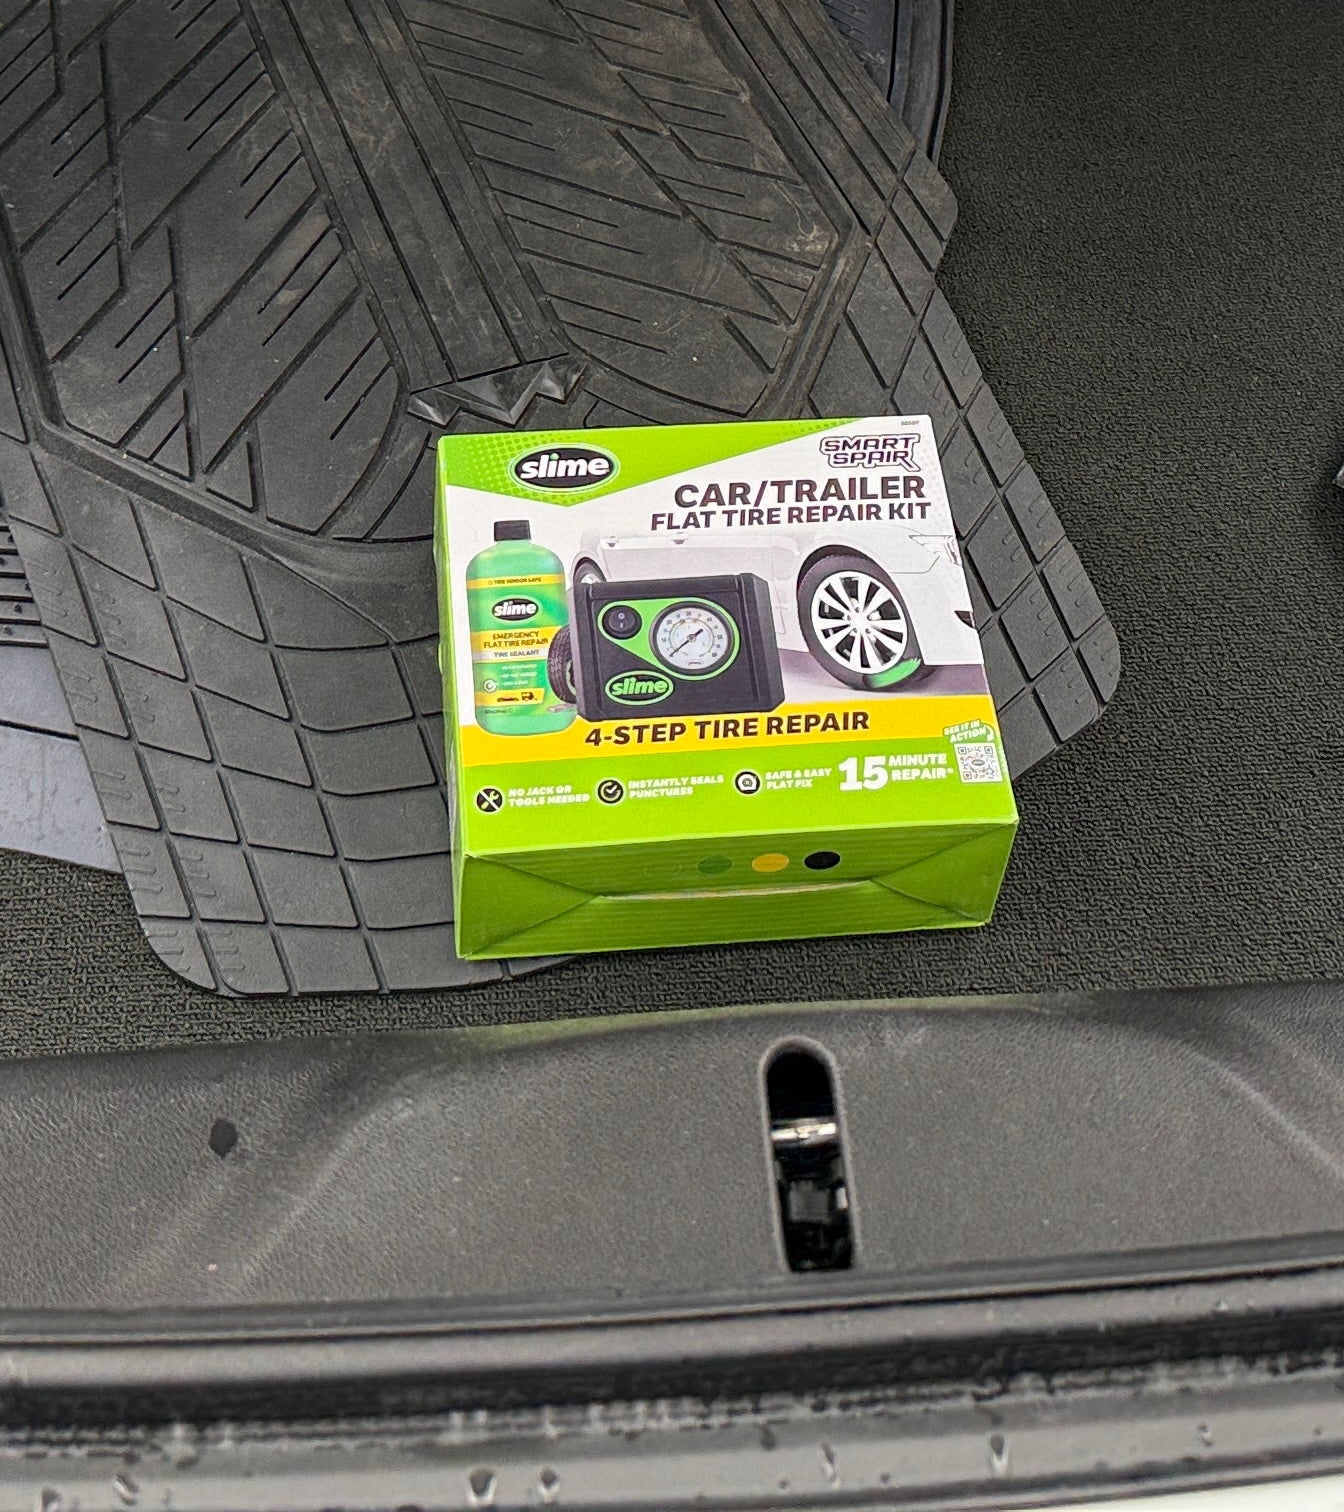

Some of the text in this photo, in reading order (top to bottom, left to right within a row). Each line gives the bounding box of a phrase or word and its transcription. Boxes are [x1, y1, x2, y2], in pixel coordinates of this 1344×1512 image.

[824, 435, 920, 451] SMART
[520, 452, 609, 479] slime
[833, 450, 919, 471] SPAIR
[674, 475, 926, 508] CAR/TRAILER
[651, 502, 932, 531] FLAT TIRE REPAIR KIT
[494, 600, 537, 617] slime
[492, 631, 540, 640] EMERGENCY
[521, 638, 548, 646] REPAIR
[612, 677, 668, 696] slime
[585, 711, 870, 747] 4-STEP TIRE REPAIR
[949, 725, 988, 744] ACTION
[888, 752, 948, 767] MINUTE
[765, 770, 793, 781] SAFE
[803, 768, 833, 778] EASY
[838, 755, 889, 791] 15
[628, 774, 725, 789] INSTANTLY SEALS
[766, 779, 814, 790] FLAT FIX
[508, 784, 573, 798] NO JACK OR
[629, 787, 694, 799] PUNCTURES
[508, 793, 591, 808] TOOLS NEEDED
